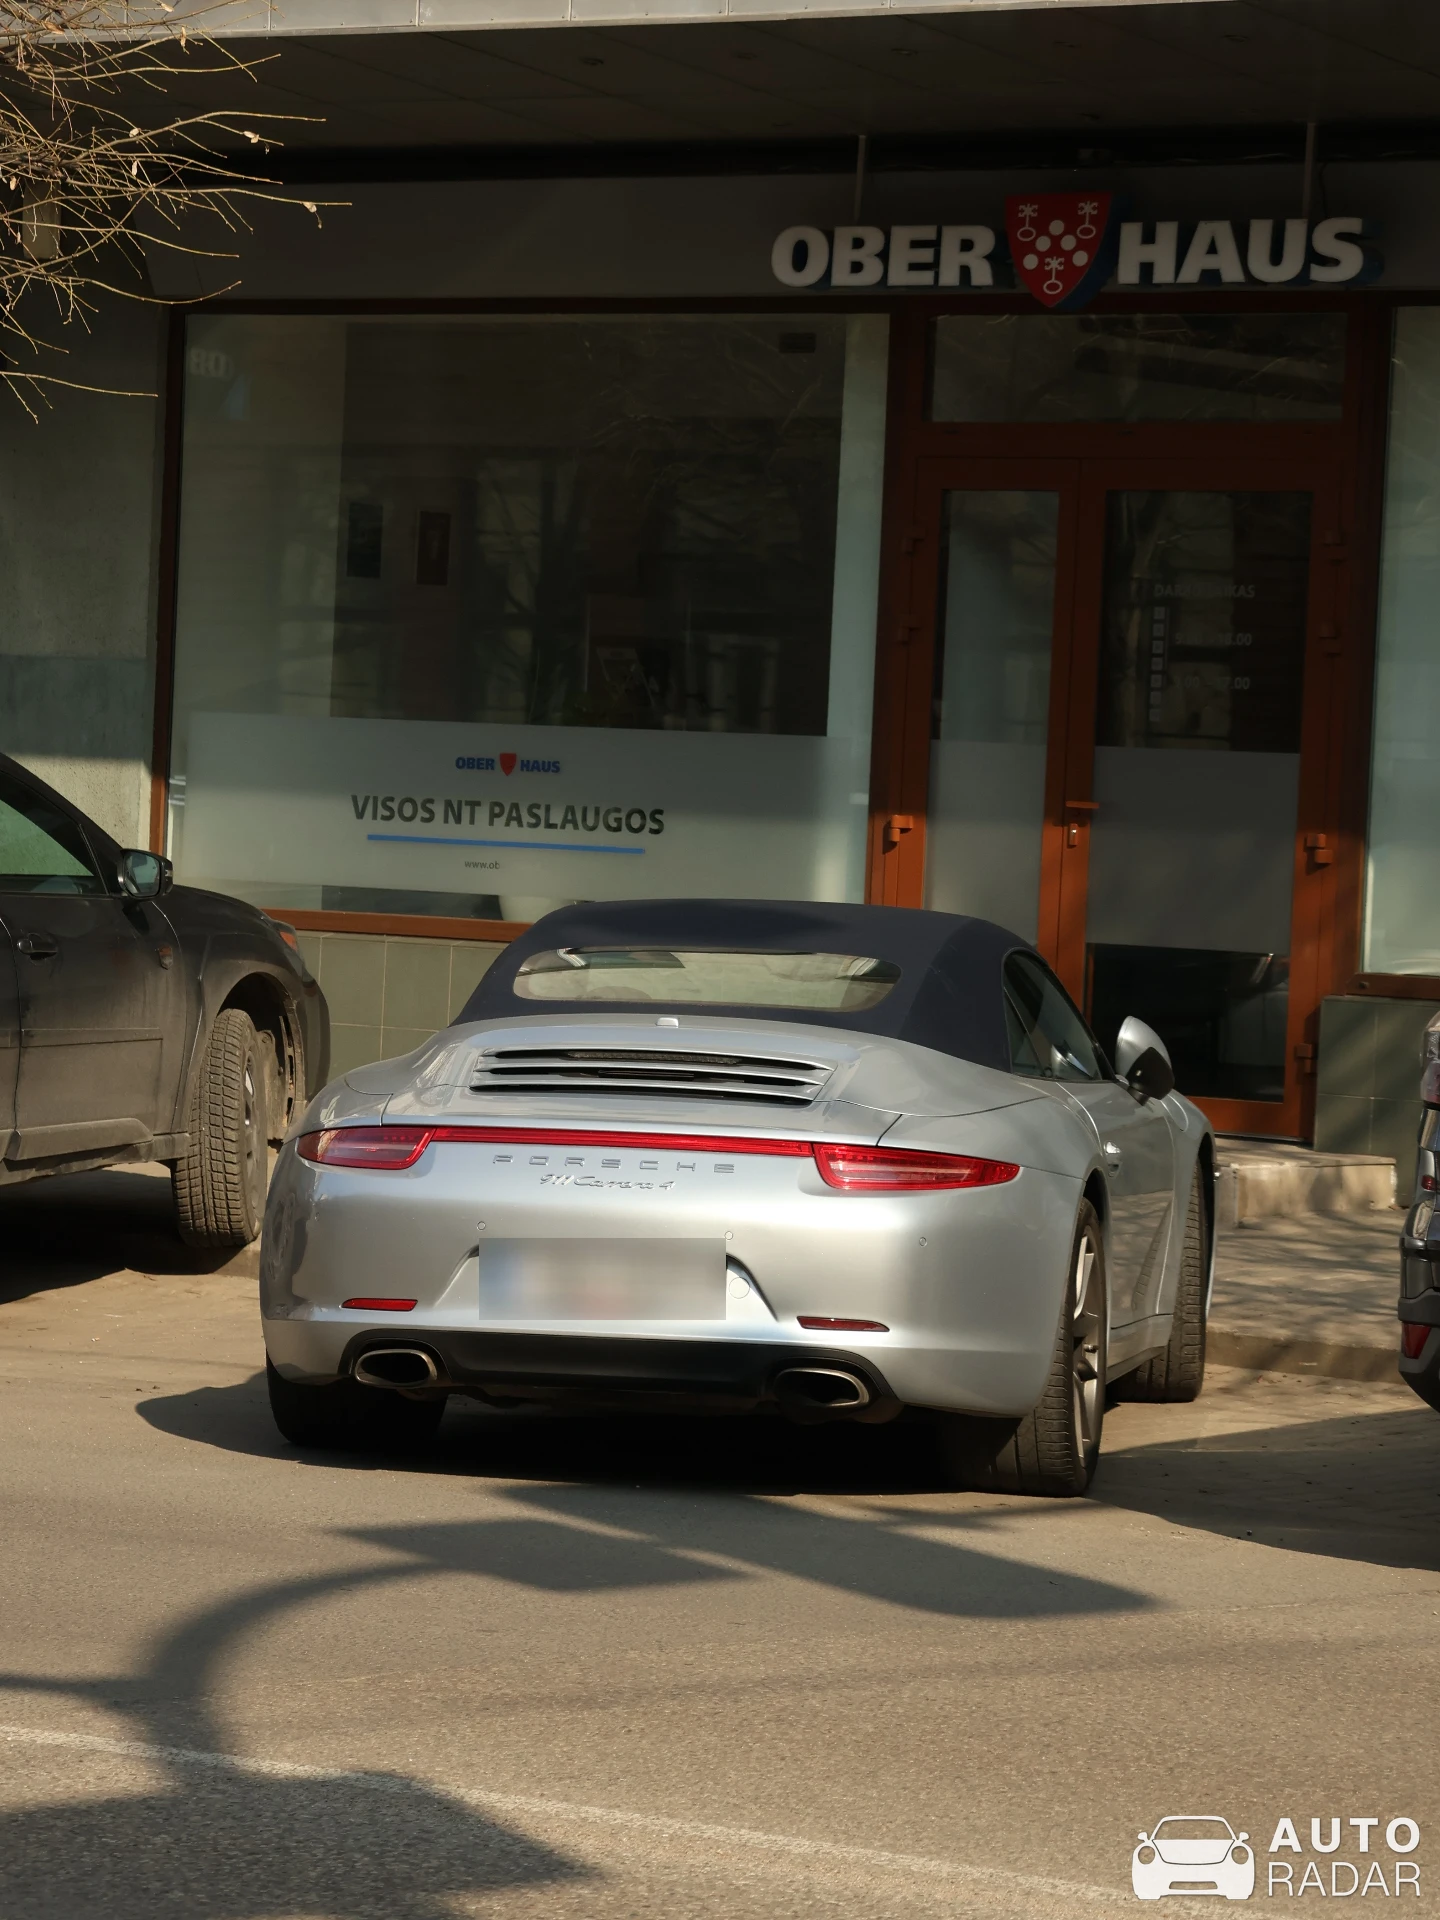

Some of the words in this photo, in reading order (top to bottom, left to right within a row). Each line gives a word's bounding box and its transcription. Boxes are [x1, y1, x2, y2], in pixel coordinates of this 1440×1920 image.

[771, 225, 996, 287] OBER
[1117, 217, 1364, 285] HAUS
[455, 756, 495, 771] OBER
[520, 759, 561, 774] HAUS
[351, 795, 435, 824] VISOS
[443, 799, 481, 825] NT
[488, 801, 665, 835] PASLAUGOS
[492, 1154, 735, 1174] PORSCHE
[540, 1173, 574, 1186] 911
[574, 1175, 655, 1190] Carrera
[659, 1180, 676, 1191] 4
